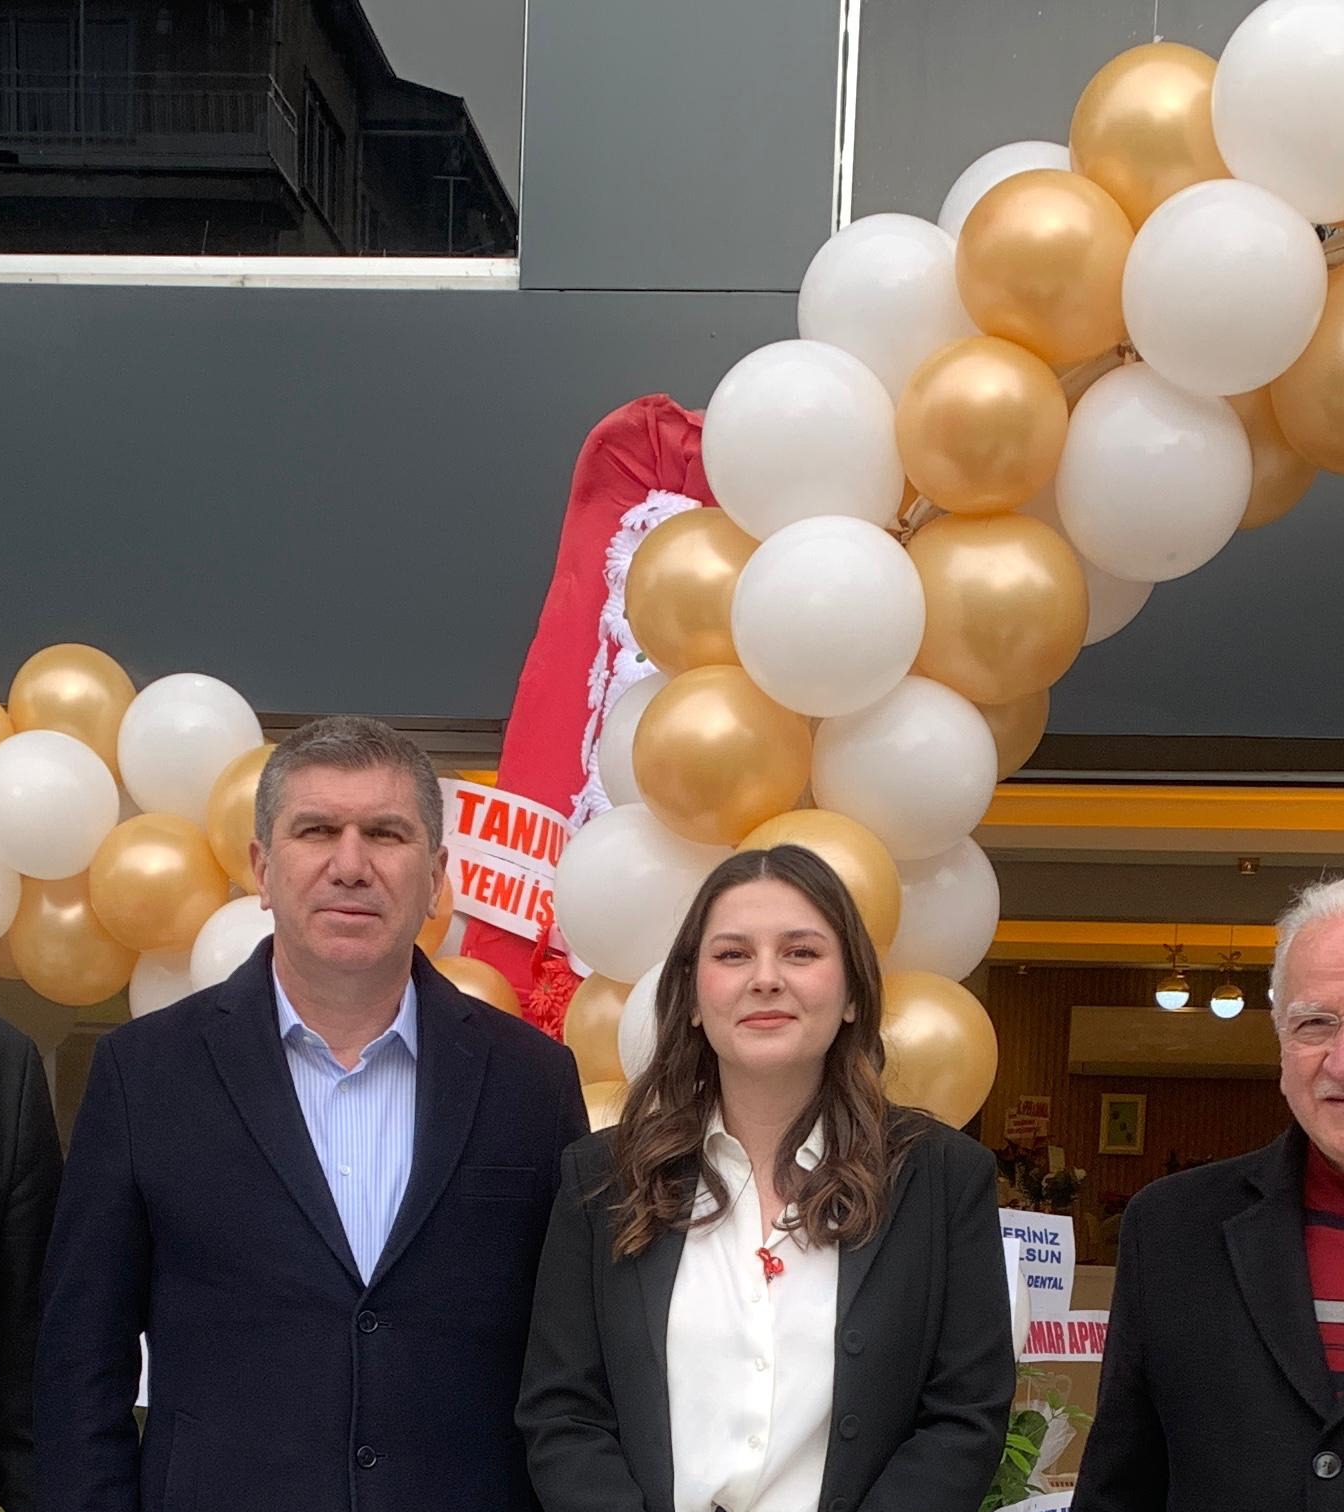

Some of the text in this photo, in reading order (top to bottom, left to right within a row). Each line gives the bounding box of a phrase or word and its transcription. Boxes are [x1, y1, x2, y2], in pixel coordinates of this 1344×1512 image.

[456, 790, 564, 868] TANJU
[460, 859, 525, 915] YENİ
[1027, 1275, 1063, 1290] DENTAL
[1023, 1321, 1066, 1354] MAR
